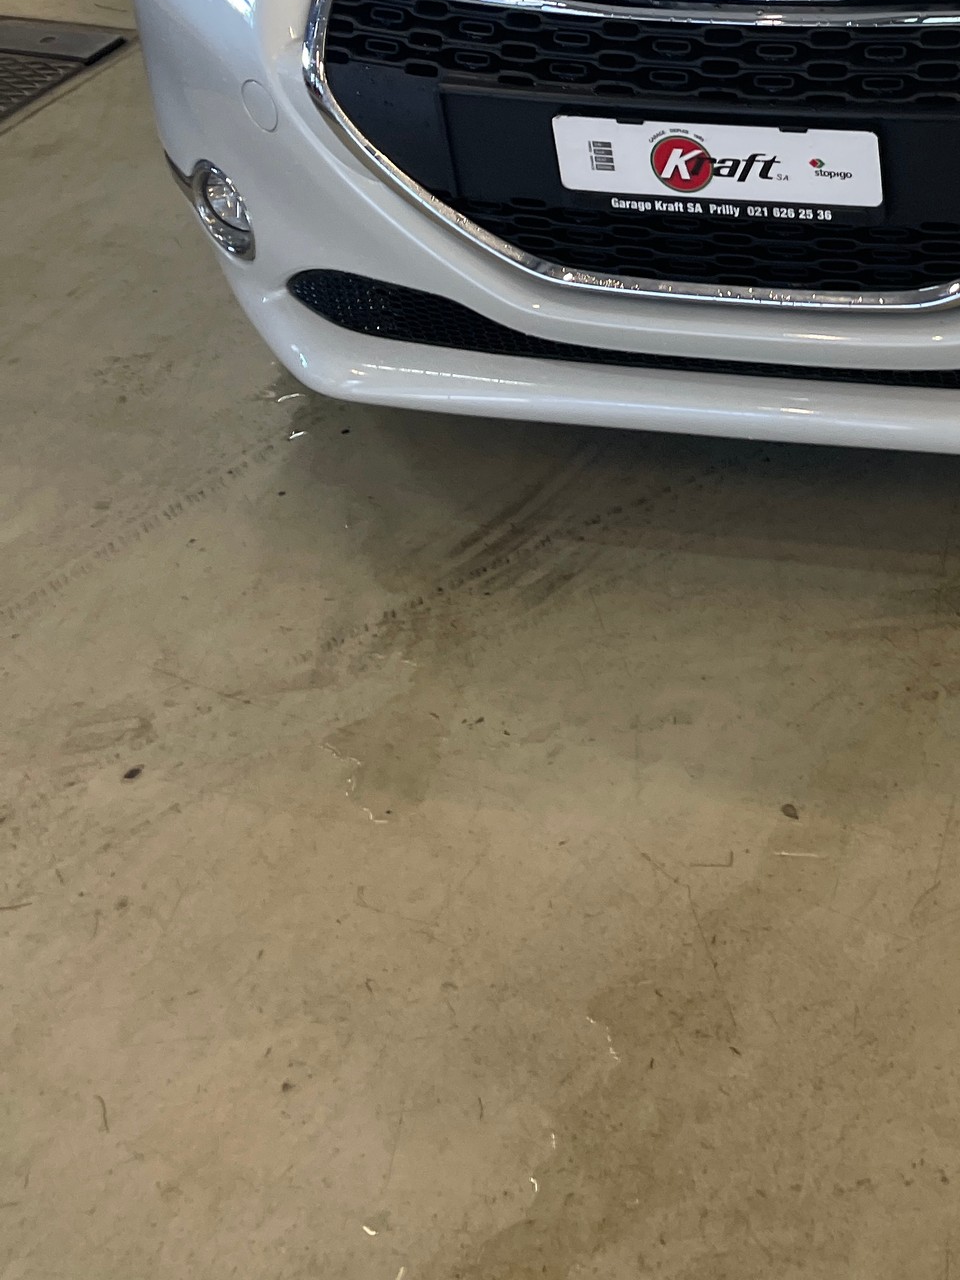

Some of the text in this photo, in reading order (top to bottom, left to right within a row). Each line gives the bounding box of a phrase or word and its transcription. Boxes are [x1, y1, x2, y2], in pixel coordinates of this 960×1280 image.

[660, 148, 781, 182] Kraft
[611, 197, 832, 221] Garage Kraft SA Prilly 021 626 25 36
